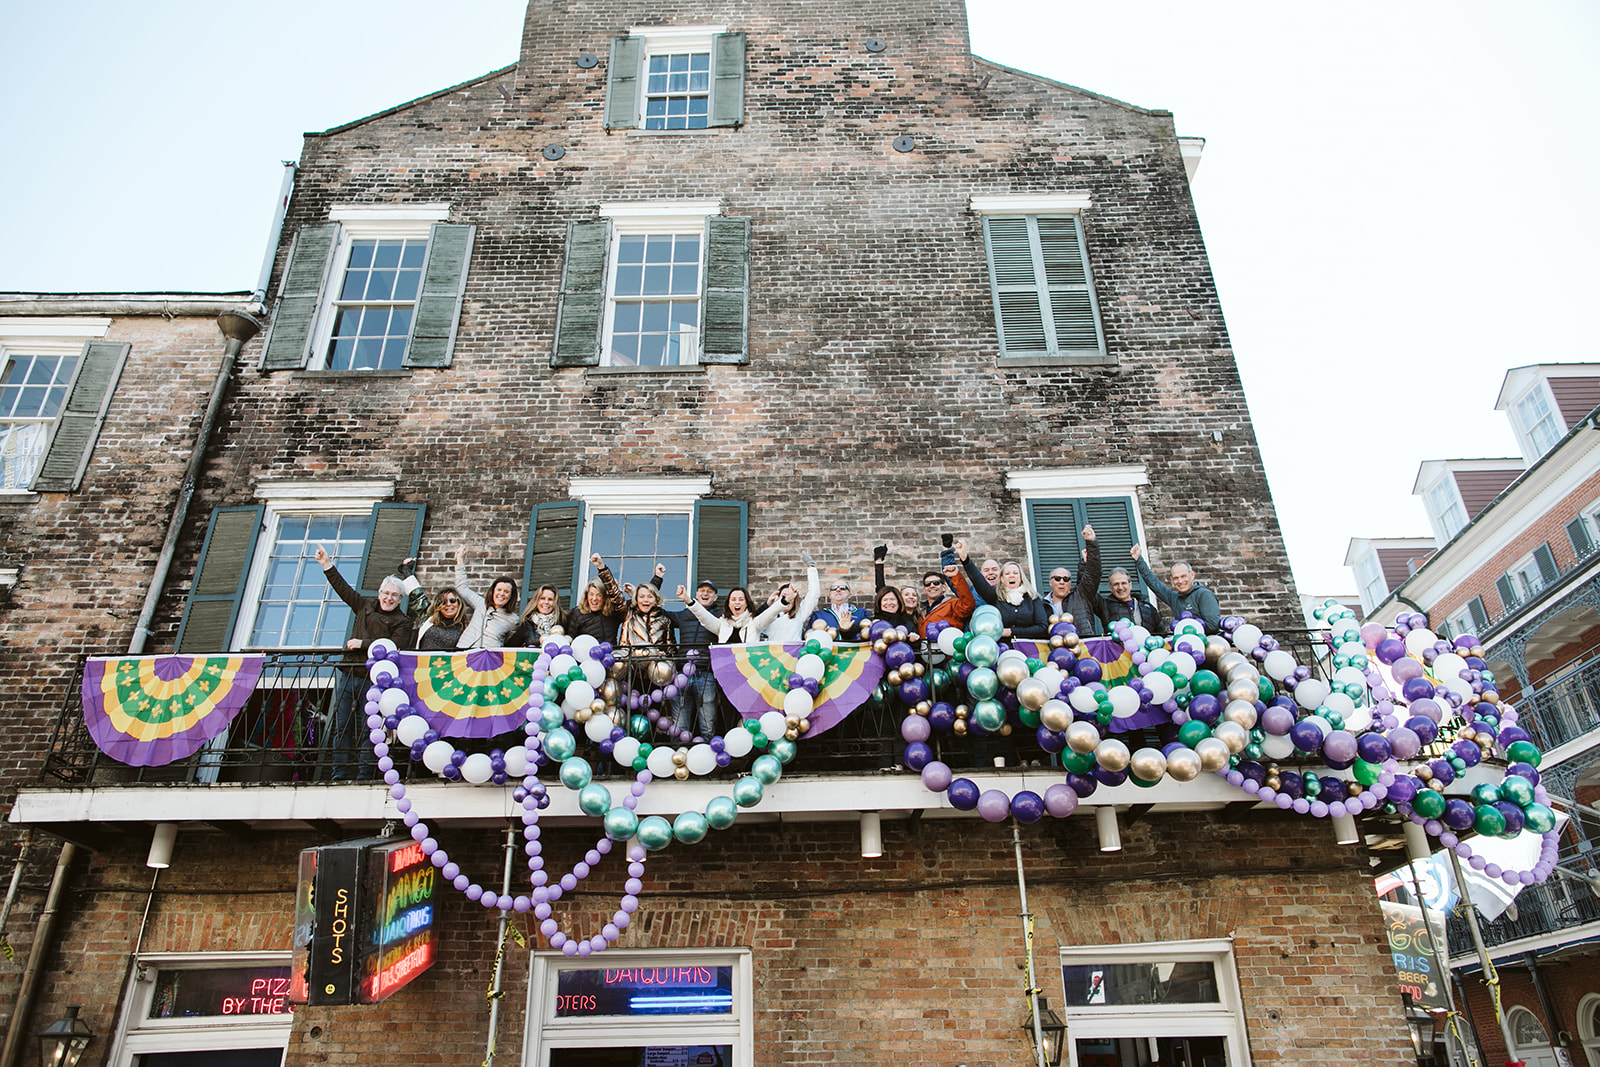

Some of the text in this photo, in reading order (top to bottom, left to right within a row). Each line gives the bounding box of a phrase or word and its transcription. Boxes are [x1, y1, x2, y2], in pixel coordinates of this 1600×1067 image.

[330, 888, 348, 964] SHOTS
[605, 967, 712, 985] DAIQUIRIS
[1398, 971, 1429, 985] BEER
[222, 997, 246, 1015] BY
[251, 997, 284, 1015] THE
